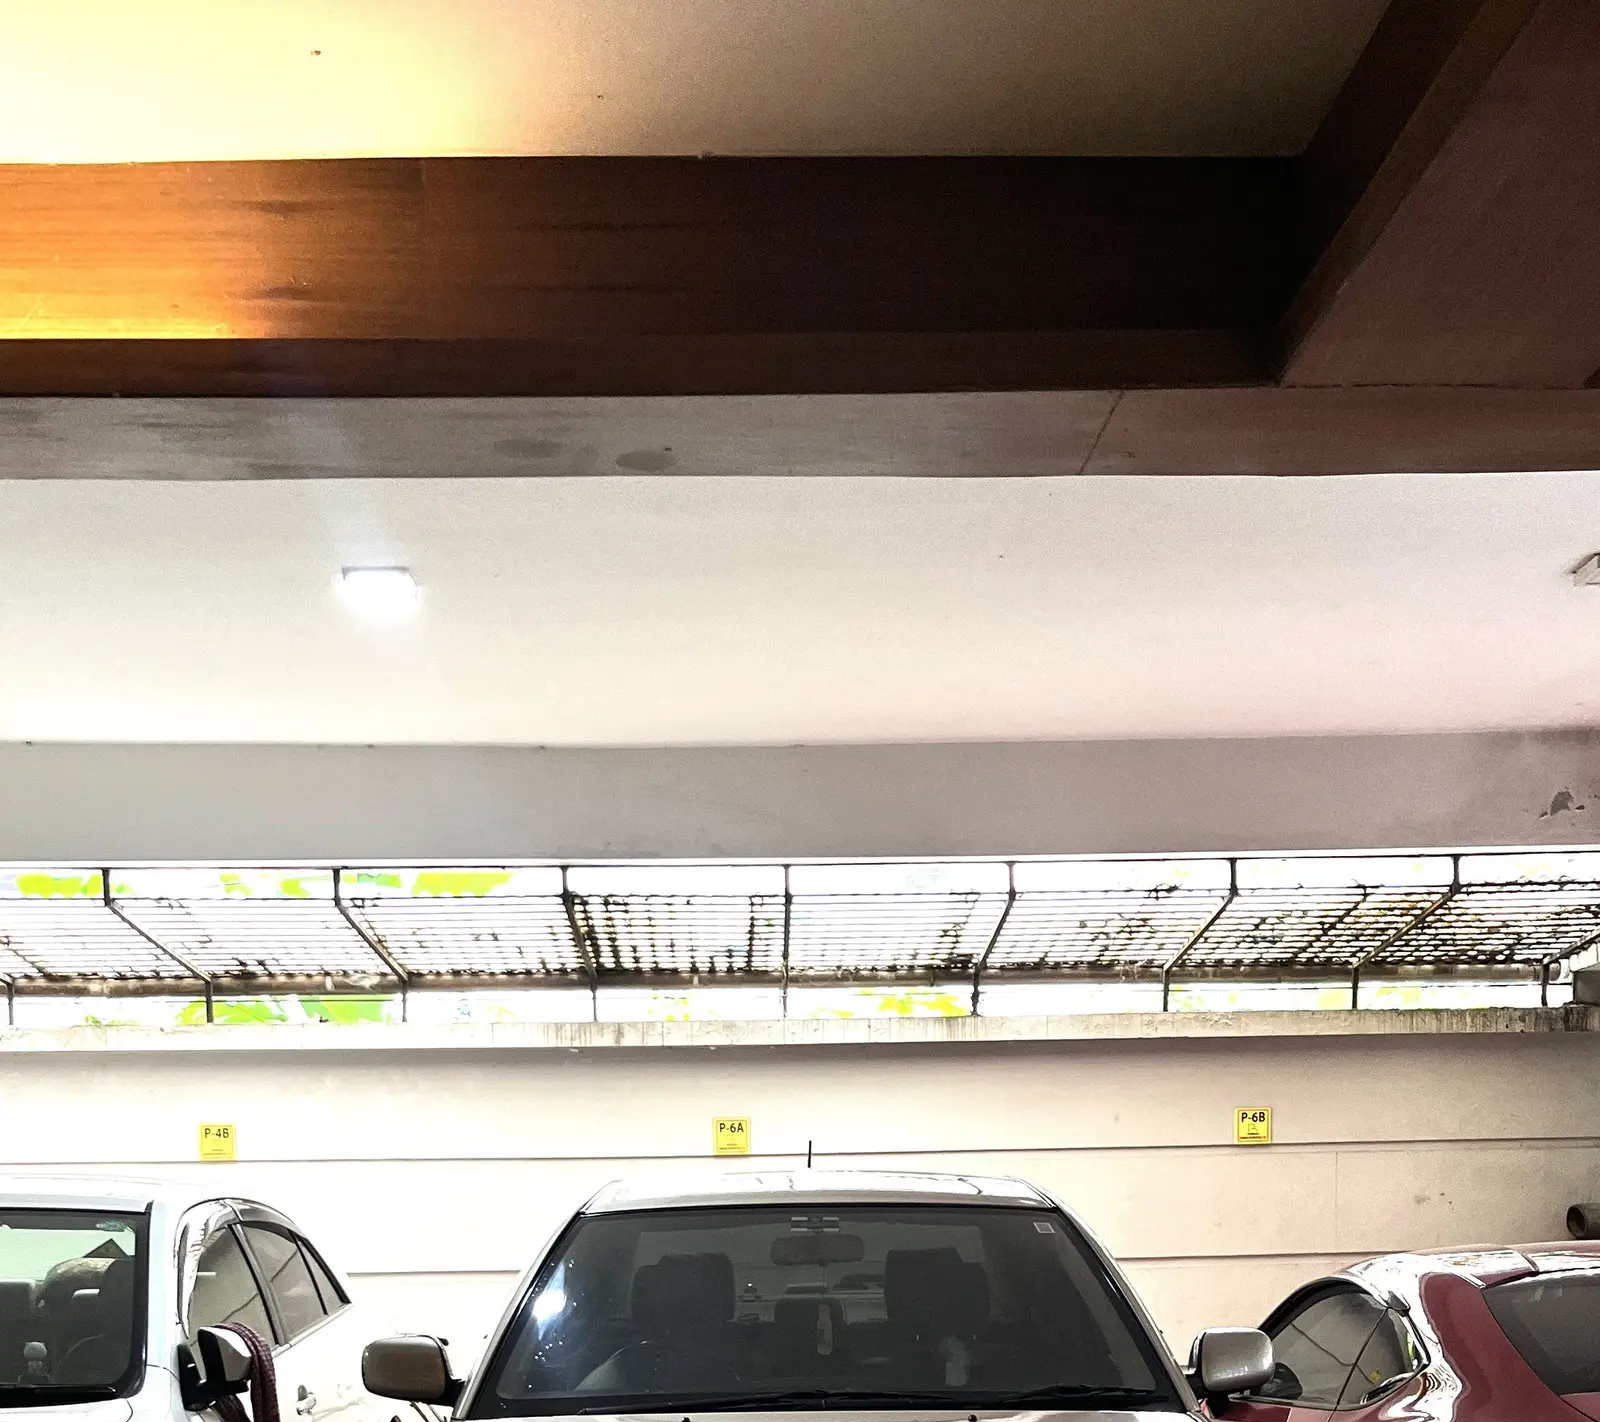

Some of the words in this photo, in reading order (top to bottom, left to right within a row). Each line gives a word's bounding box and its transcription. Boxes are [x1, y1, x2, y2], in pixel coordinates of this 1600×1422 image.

[1241, 1111, 1265, 1122] P-6B
[204, 1127, 229, 1139] P-4B
[719, 1122, 744, 1133] P-6A
